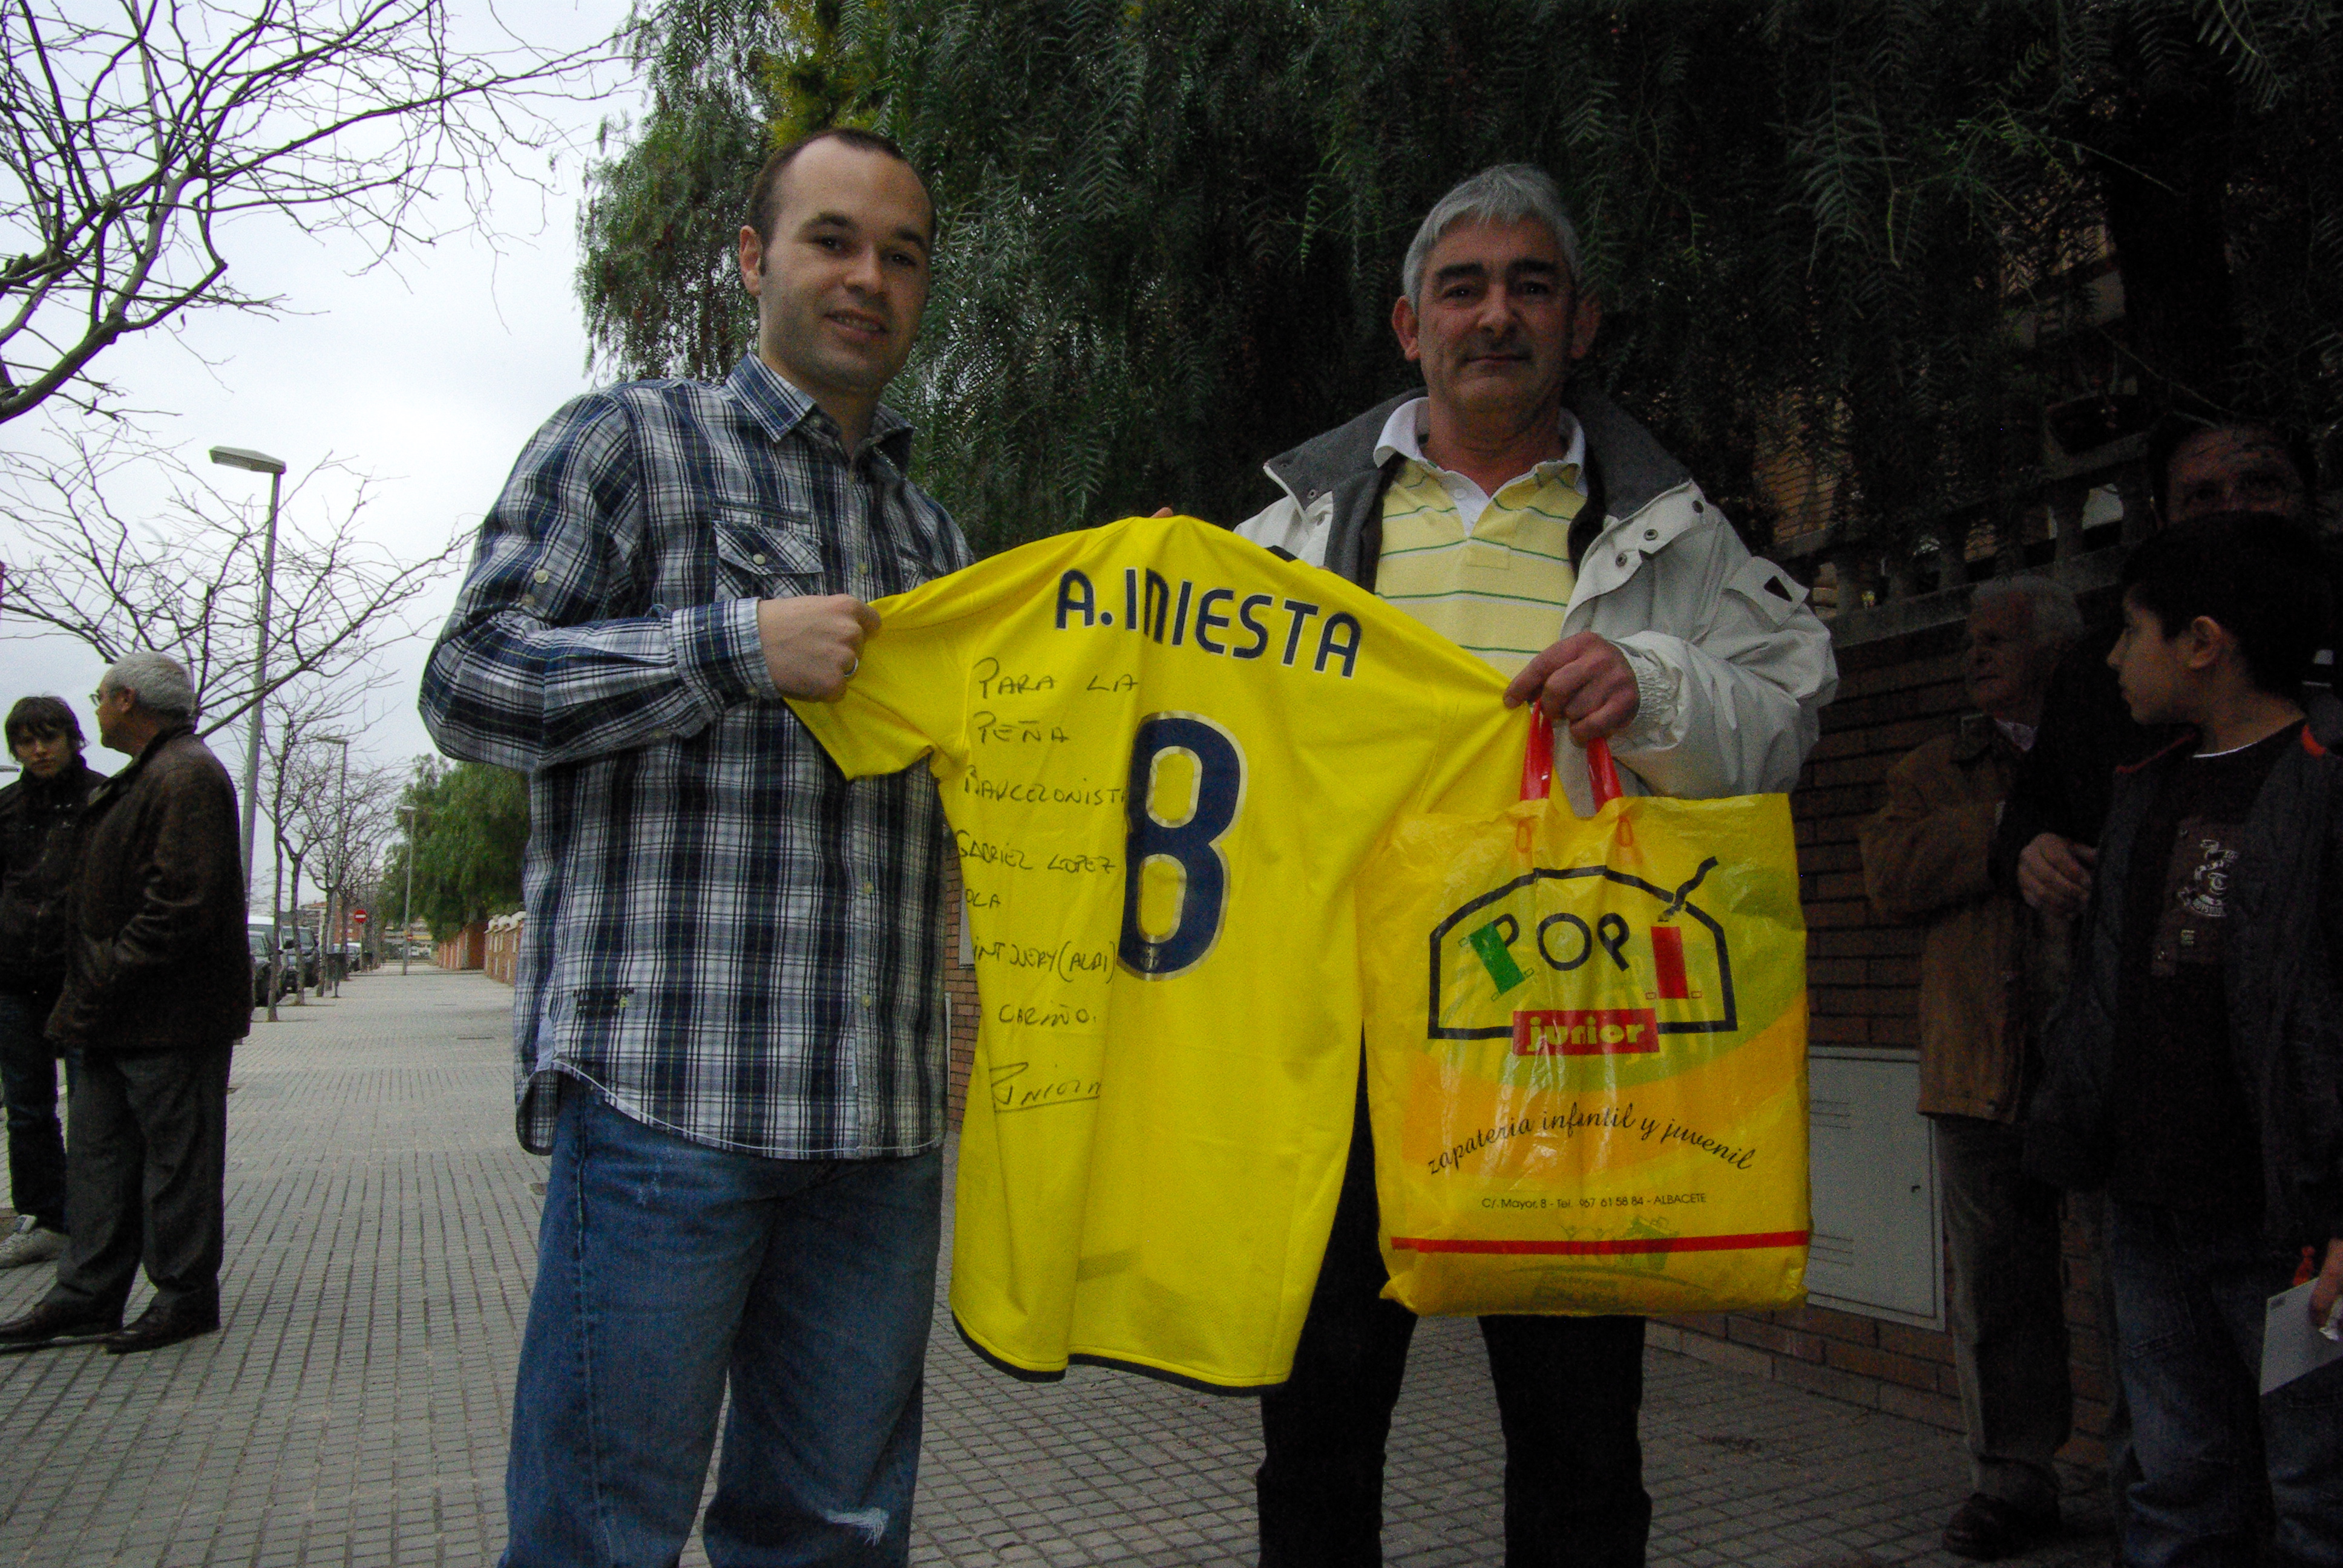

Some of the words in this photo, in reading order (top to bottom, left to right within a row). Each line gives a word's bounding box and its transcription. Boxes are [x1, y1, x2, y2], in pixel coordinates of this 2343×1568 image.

[973, 657, 1054, 699] PARA
[1086, 674, 1138, 691] LA
[1117, 710, 1248, 982] 8
[1527, 1016, 1645, 1052] junior
[1542, 1102, 1636, 1137] infantil
[1640, 1118, 1660, 1141] y
[1660, 1118, 1755, 1170] juvenil
[1540, 1198, 1547, 1208] 8
[1654, 1193, 1706, 1205] ALBACETE
